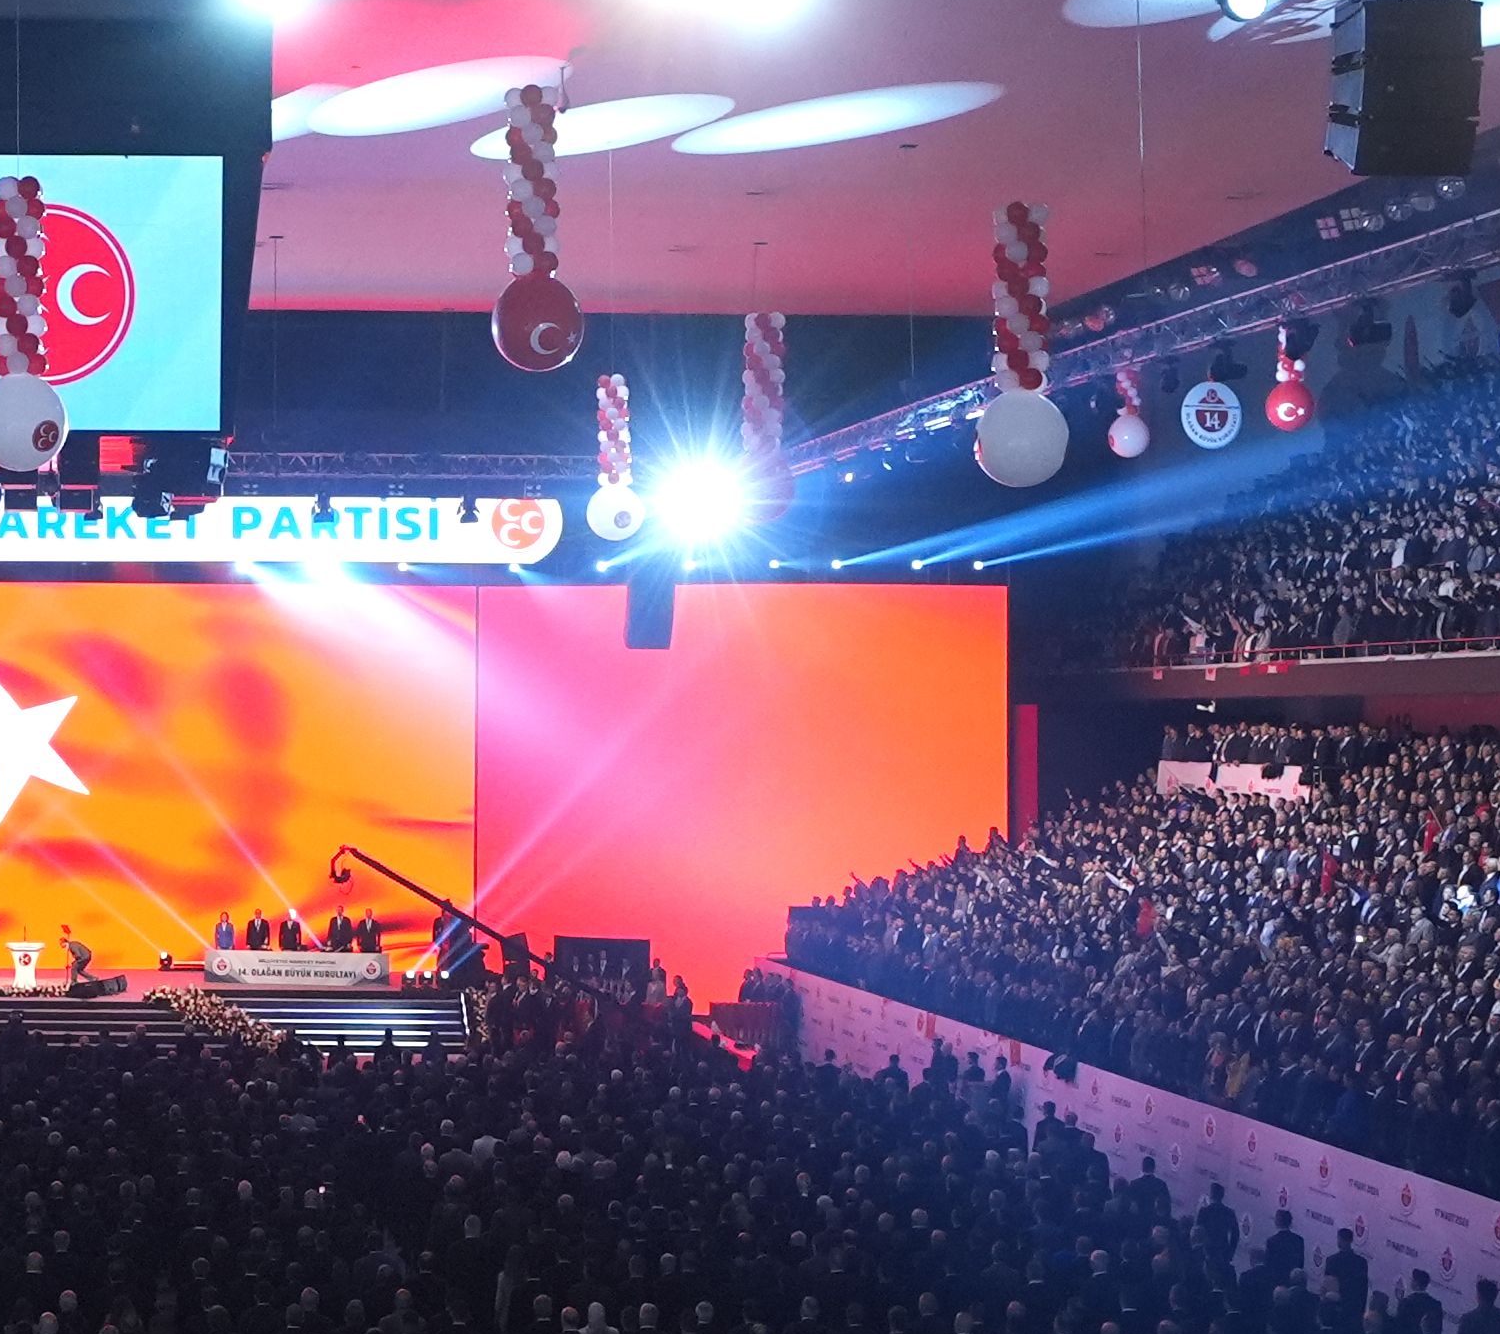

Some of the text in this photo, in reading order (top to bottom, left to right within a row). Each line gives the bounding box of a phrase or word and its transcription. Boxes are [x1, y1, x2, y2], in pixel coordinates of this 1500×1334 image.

[251, 967, 282, 977] OLAĞAN
[285, 967, 311, 978] BÜYÜK
[313, 969, 357, 979] KURULTAYI
